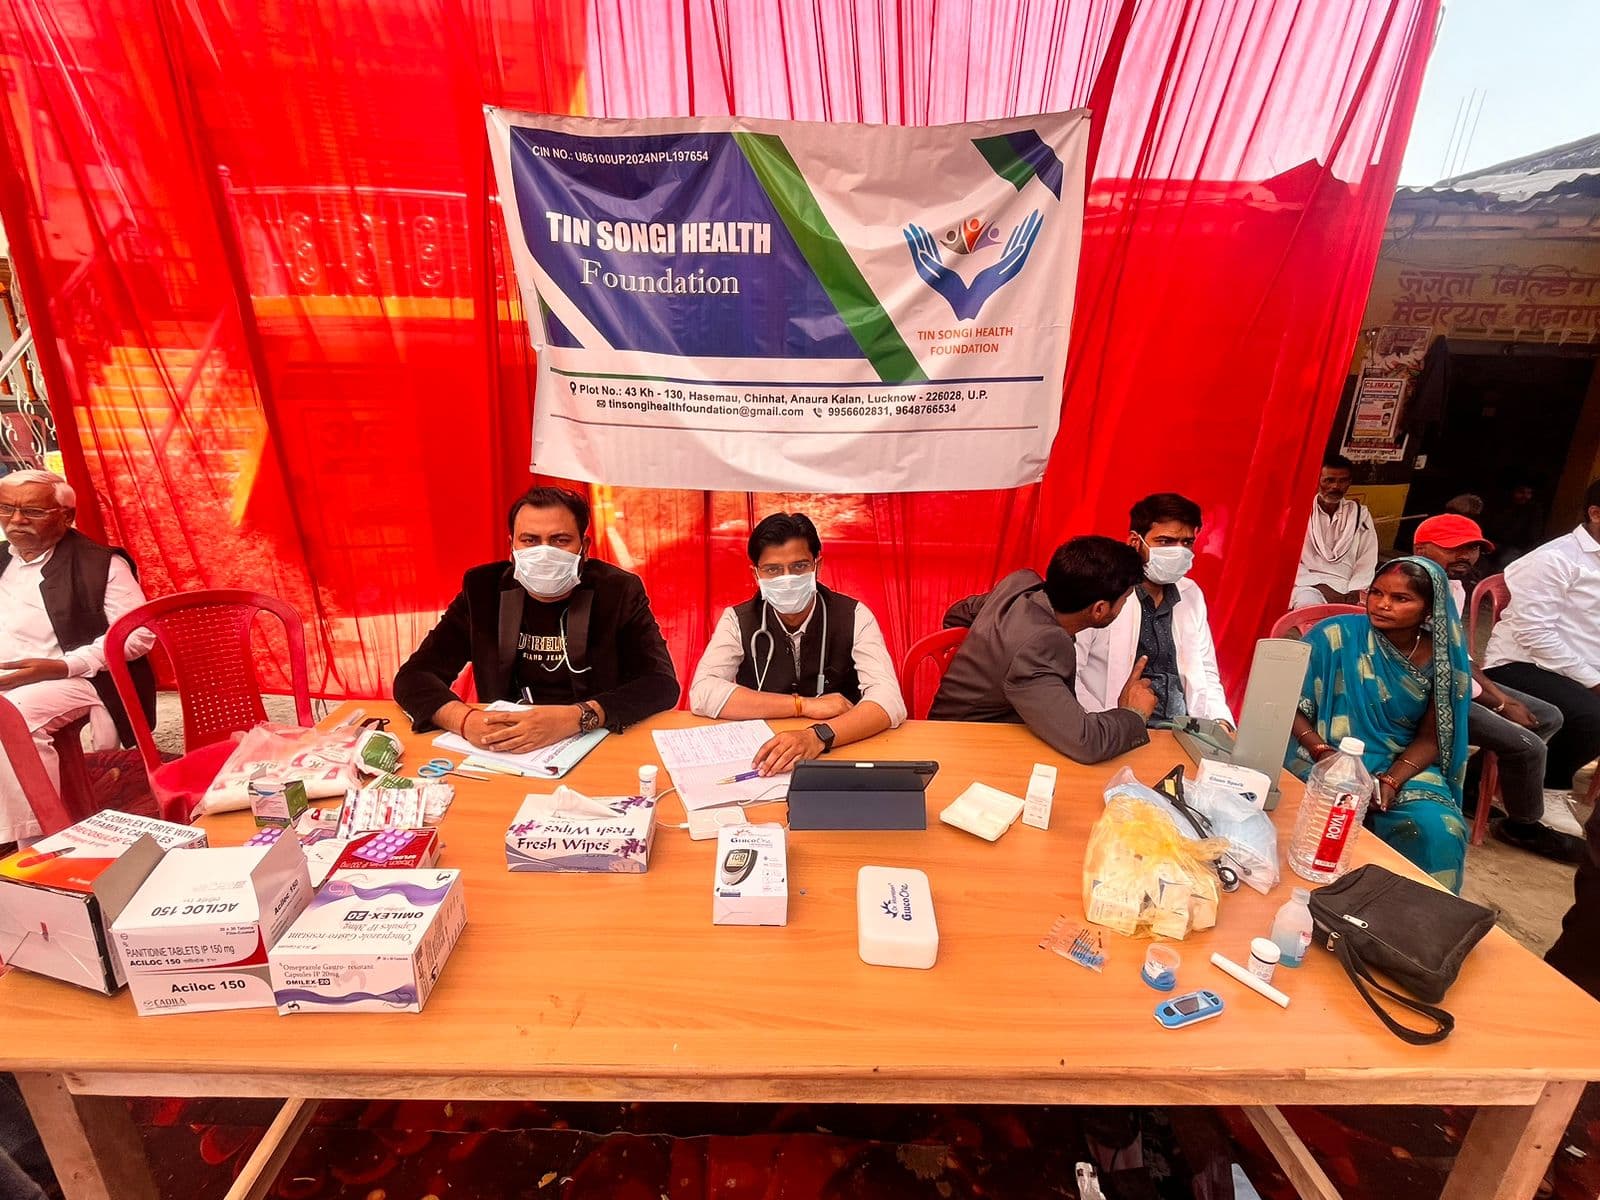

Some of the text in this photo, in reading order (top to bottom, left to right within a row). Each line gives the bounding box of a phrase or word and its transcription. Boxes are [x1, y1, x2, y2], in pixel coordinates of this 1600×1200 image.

[532, 145, 709, 165] CIN NO.: U86100UP2024NPL197654
[545, 211, 771, 254] TIN SONGI HEALTH
[579, 258, 740, 294] Foundation
[917, 326, 1014, 341] TIN SONGI HEALTH
[930, 343, 999, 356] FOUNDATION
[579, 384, 600, 396] Plot
[601, 386, 622, 397] No.:
[624, 386, 638, 398] 43
[639, 387, 654, 398] Kh
[664, 389, 686, 401] 130,
[689, 391, 741, 405] Hasemau,
[743, 393, 788, 405] Chinhat,
[790, 394, 829, 405] Anaura
[831, 394, 865, 406] Kalan,
[867, 393, 917, 404] Lucknow
[925, 390, 965, 403] 226028,
[967, 390, 988, 401] U.P.
[608, 400, 957, 418] tinsongihealthfoundation@gmail.com 9956602831, 9648766534
[86, 818, 120, 832] VITAMIN
[96, 812, 198, 839] B-COMPLEX FORTE WITH
[544, 824, 635, 836] Fresh Wipes
[1325, 813, 1347, 840] ROYAL
[517, 837, 610, 853] Fresh Wipes
[151, 902, 240, 917] ACILOC 150
[168, 946, 200, 956] TABLETS
[210, 945, 222, 954] 150
[223, 945, 235, 955] mg
[130, 959, 163, 967] ACILOC
[165, 958, 181, 966] 150
[283, 963, 321, 972] Omeprazole
[171, 980, 246, 993] Aciloc 150
